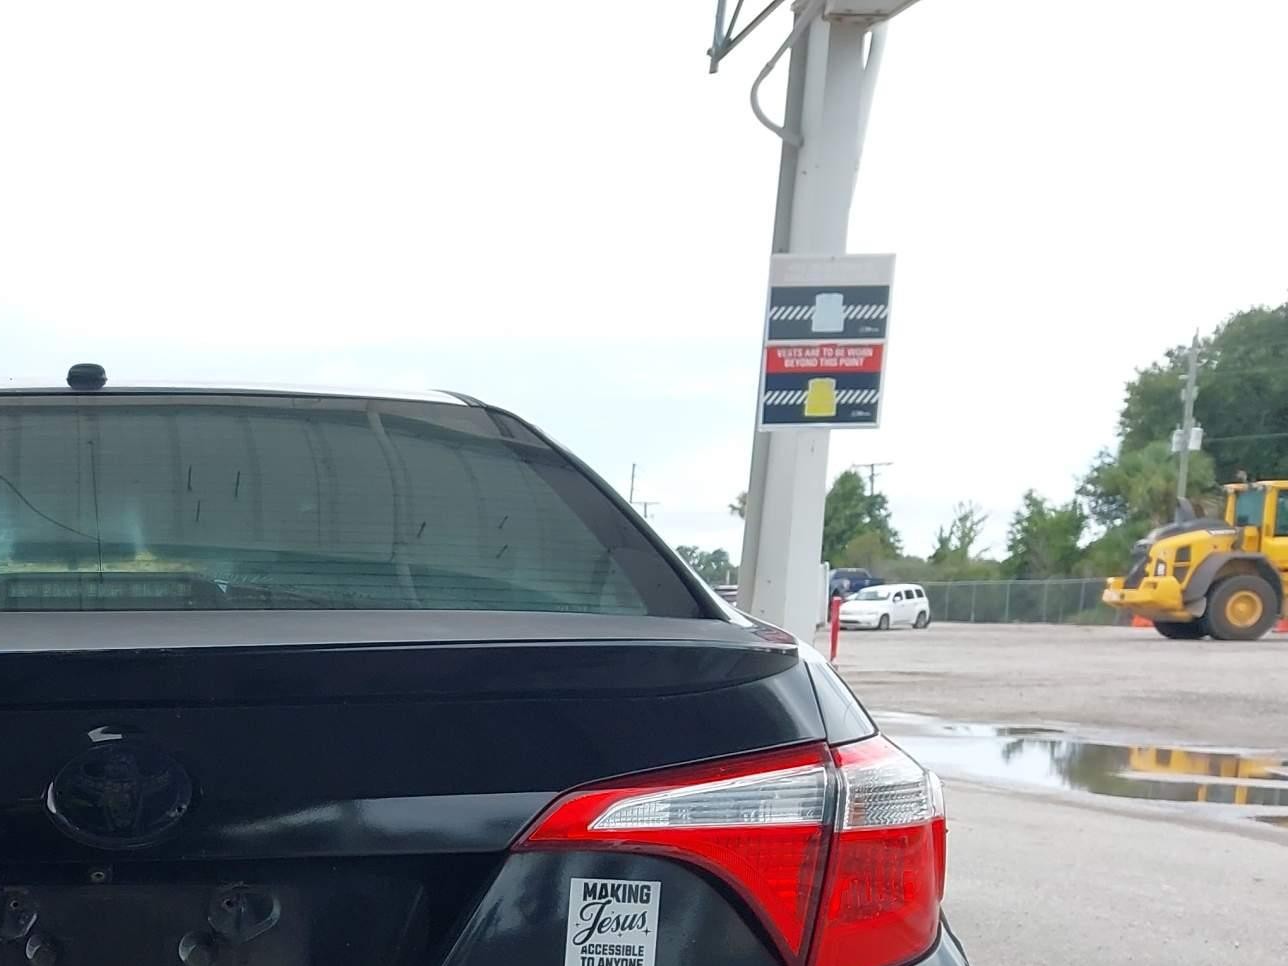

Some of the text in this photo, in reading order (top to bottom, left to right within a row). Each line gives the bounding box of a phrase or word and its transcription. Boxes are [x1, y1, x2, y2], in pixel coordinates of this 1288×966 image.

[823, 347, 833, 357] TO
[582, 882, 652, 904] MAKING
[572, 899, 648, 946] Jesus
[580, 943, 645, 957] ACCESSIBLE
